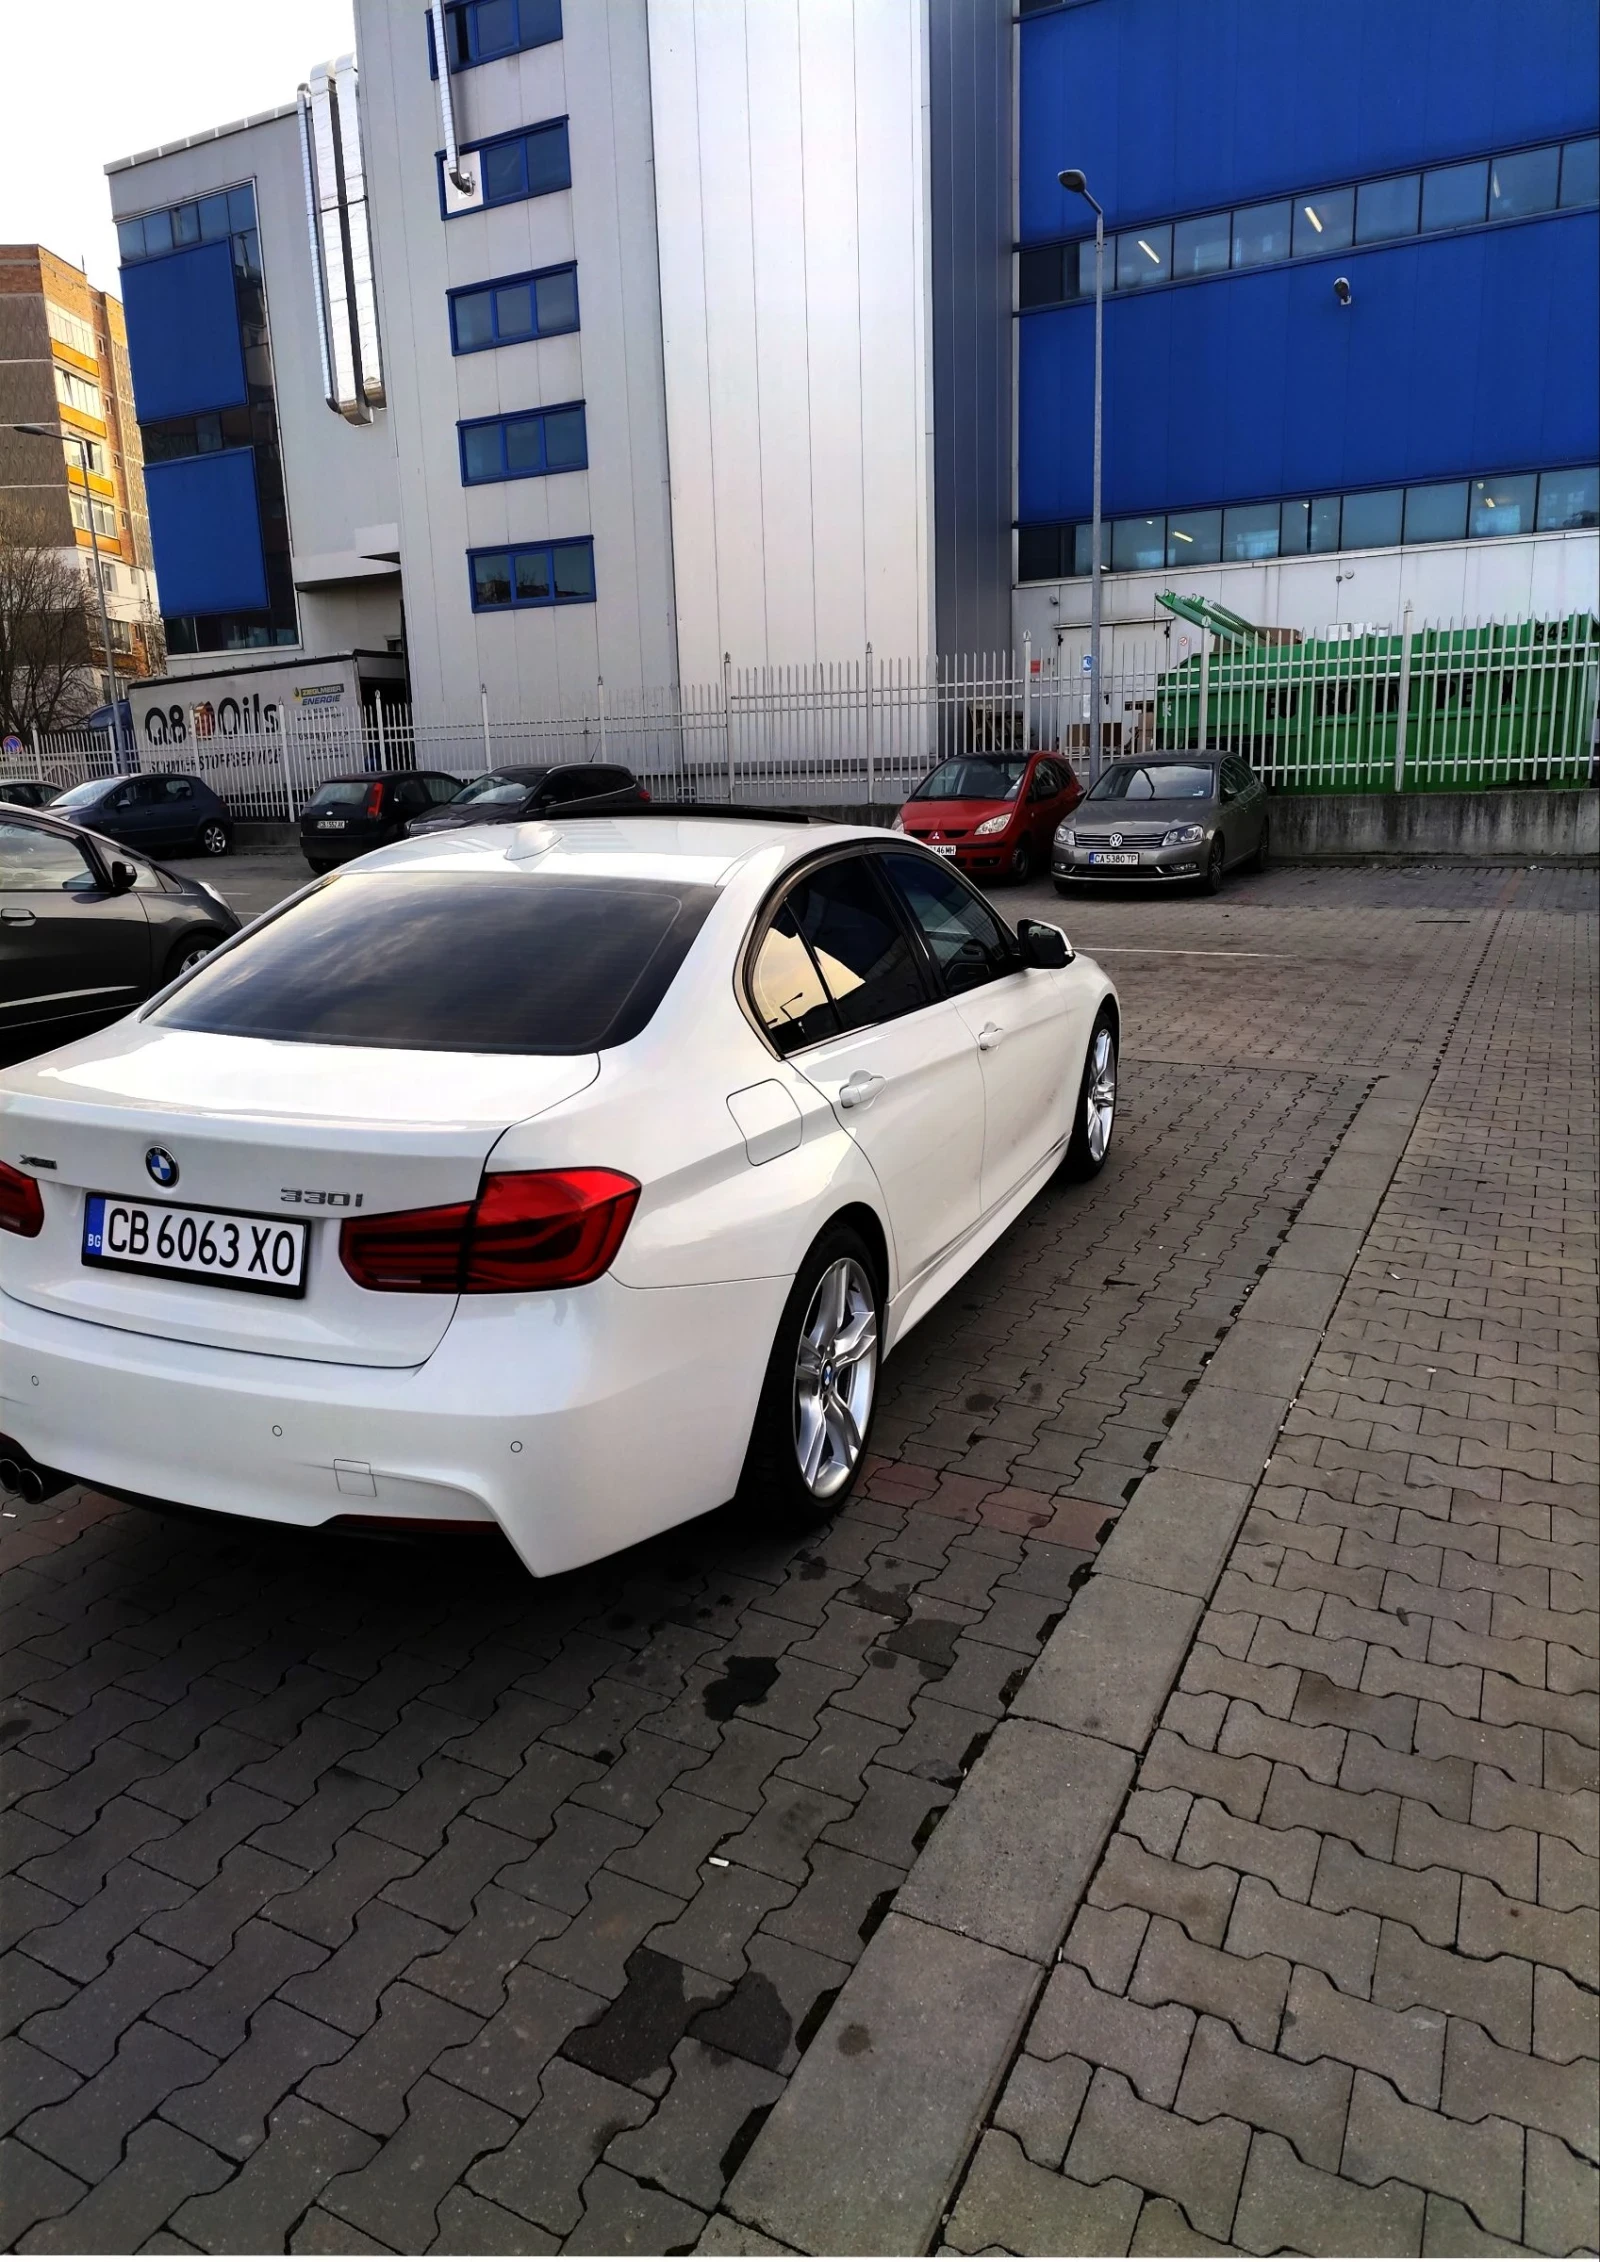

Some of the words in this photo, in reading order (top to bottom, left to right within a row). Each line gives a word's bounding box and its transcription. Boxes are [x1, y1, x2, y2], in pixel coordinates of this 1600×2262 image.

[302, 695, 341, 706] ENERGIE
[145, 707, 187, 746] Q8
[218, 693, 279, 739] Oils
[1094, 854, 1105, 863] CA
[1106, 854, 1126, 863] 5380
[1126, 854, 1137, 863] TP
[87, 1233, 102, 1248] BG
[108, 1207, 149, 1255] CB
[156, 1214, 240, 1269] 6063
[247, 1225, 295, 1277] XO
